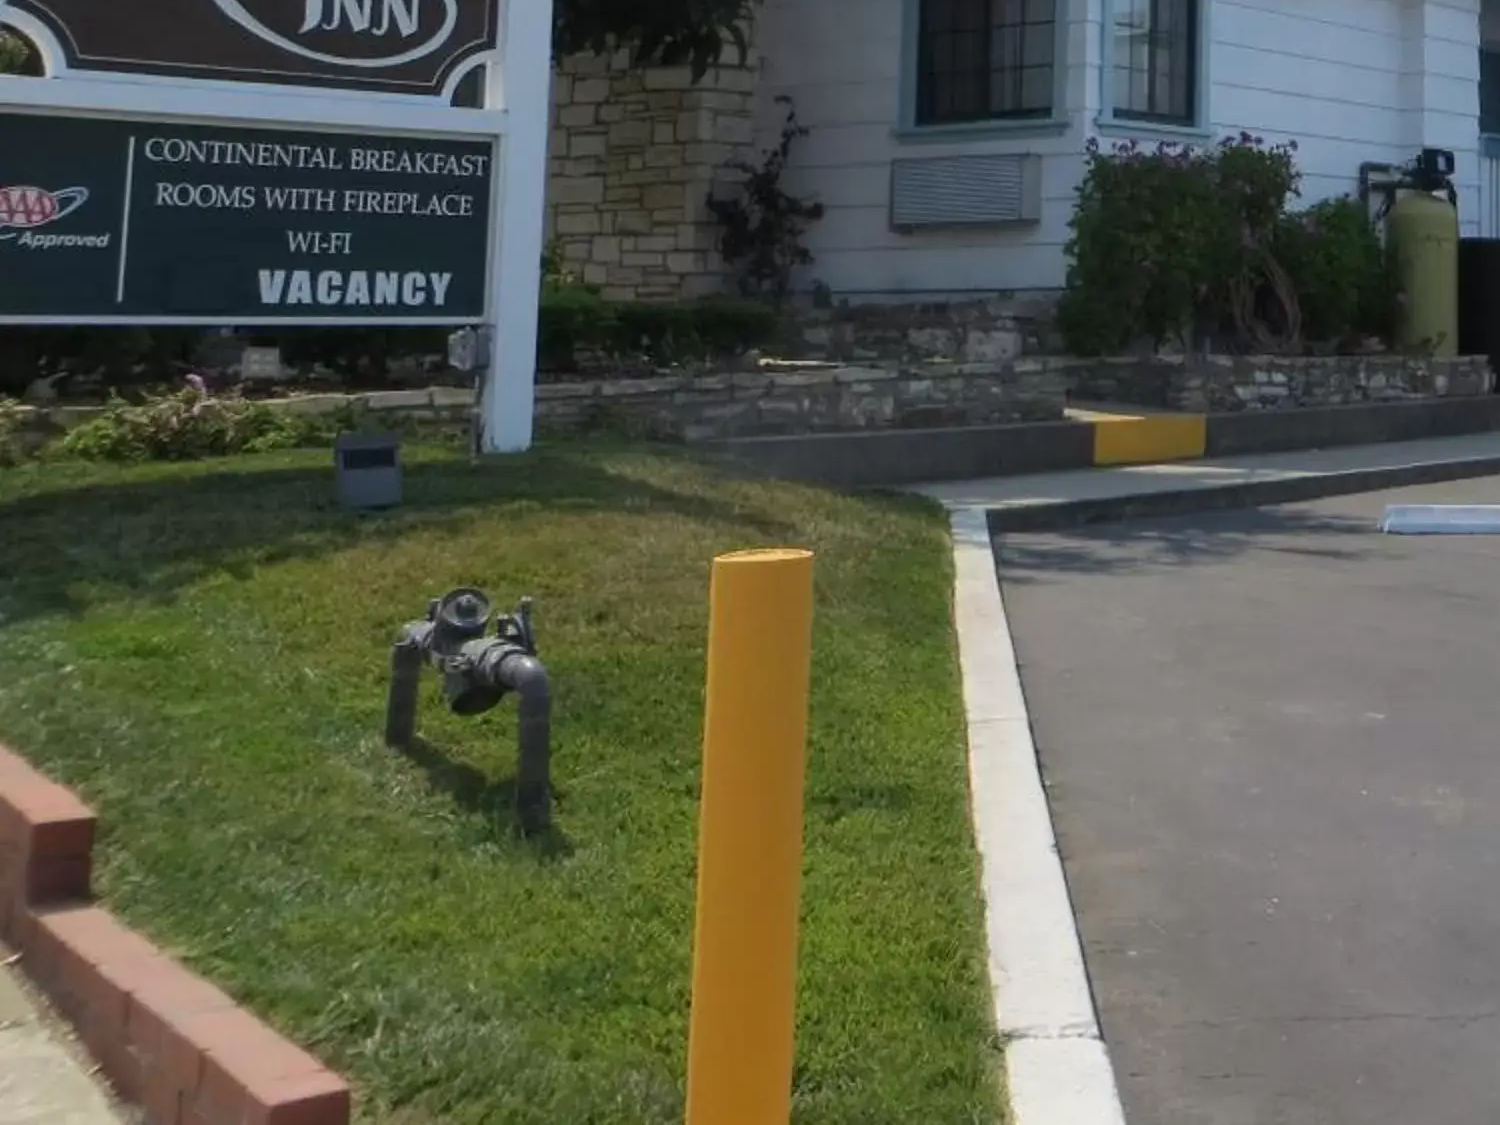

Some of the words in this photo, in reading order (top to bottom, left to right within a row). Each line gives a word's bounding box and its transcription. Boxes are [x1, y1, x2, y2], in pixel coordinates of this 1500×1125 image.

[144, 138, 343, 170] CONTINENTAL
[350, 148, 488, 176] BREAKFAST
[156, 182, 256, 208] ROOMS
[264, 188, 335, 212] WITH
[343, 190, 474, 217] FIREPLACE
[17, 230, 112, 250] Approved
[286, 230, 353, 254] WI-FI
[258, 269, 453, 306] VACANCY
